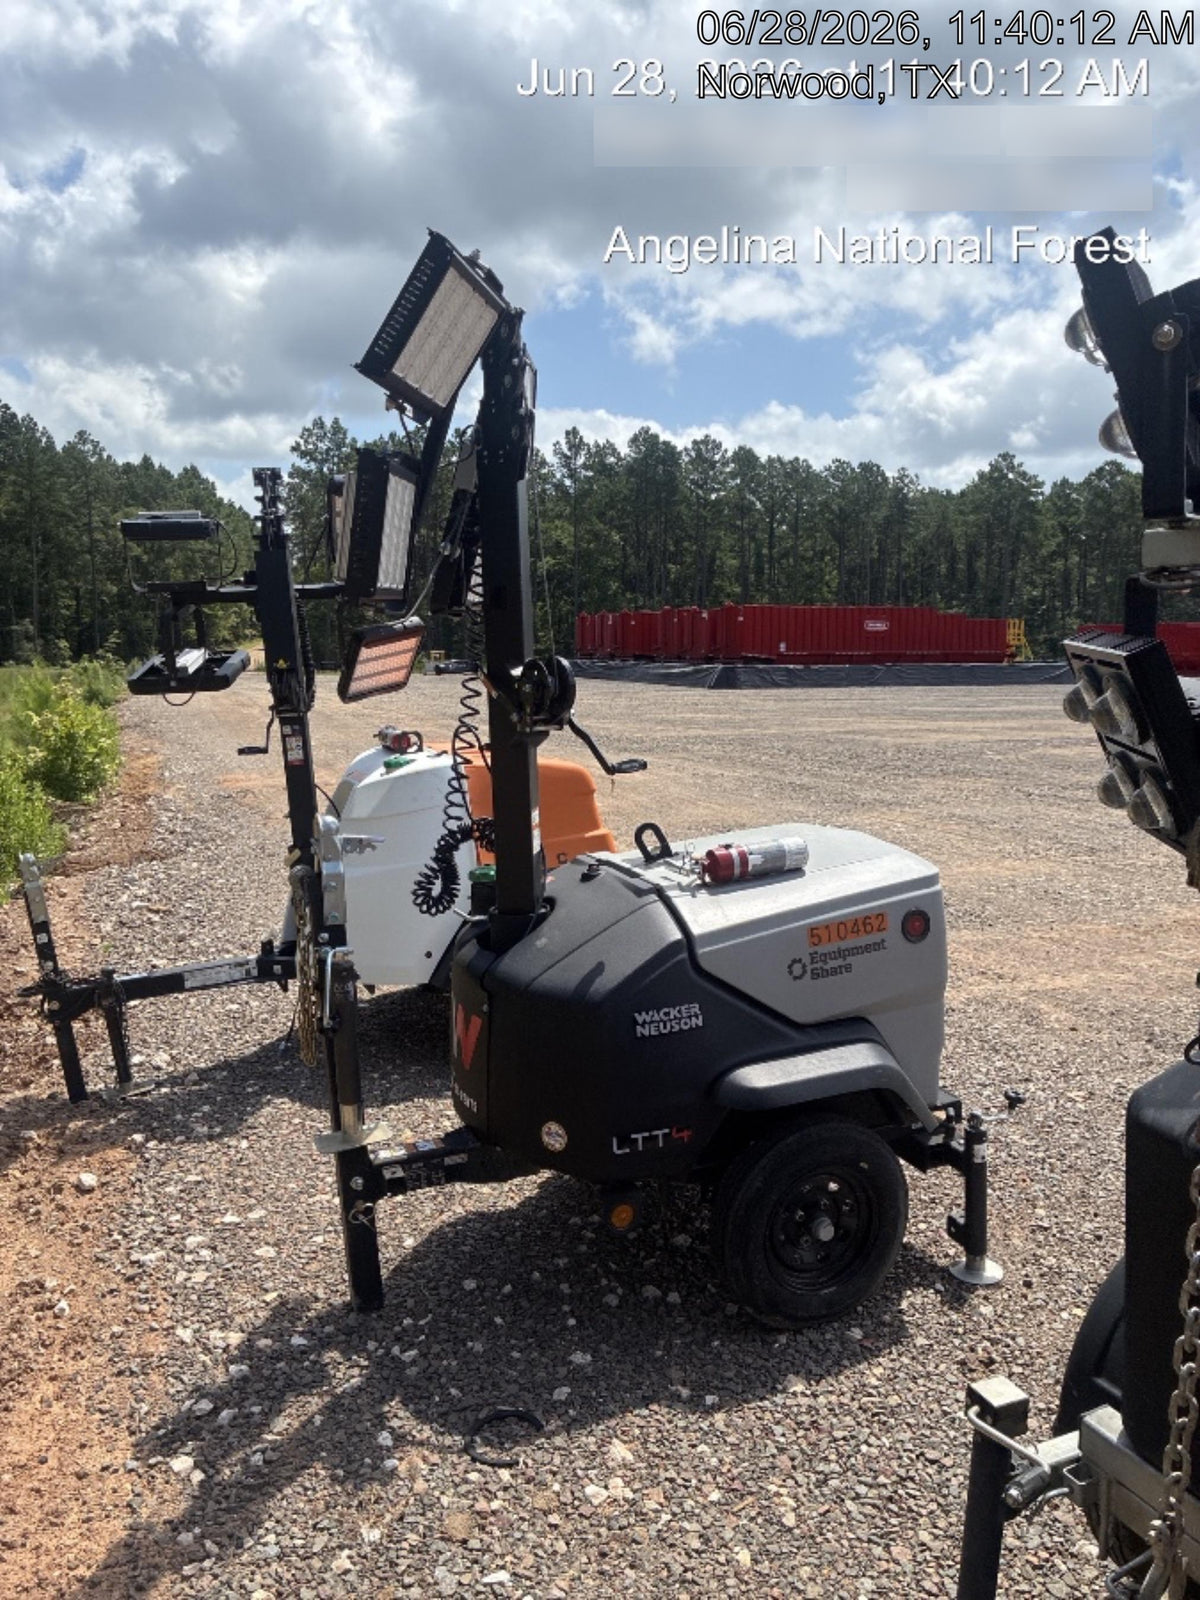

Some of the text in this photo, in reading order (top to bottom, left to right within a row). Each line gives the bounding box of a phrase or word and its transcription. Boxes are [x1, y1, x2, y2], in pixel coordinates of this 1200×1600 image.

[810, 913, 887, 946] 510462
[809, 938, 888, 966] Equipment
[809, 962, 853, 980] Share
[634, 1003, 701, 1023] WACKER
[636, 1015, 704, 1037] NEUSON
[612, 1128, 692, 1155] LTT4
